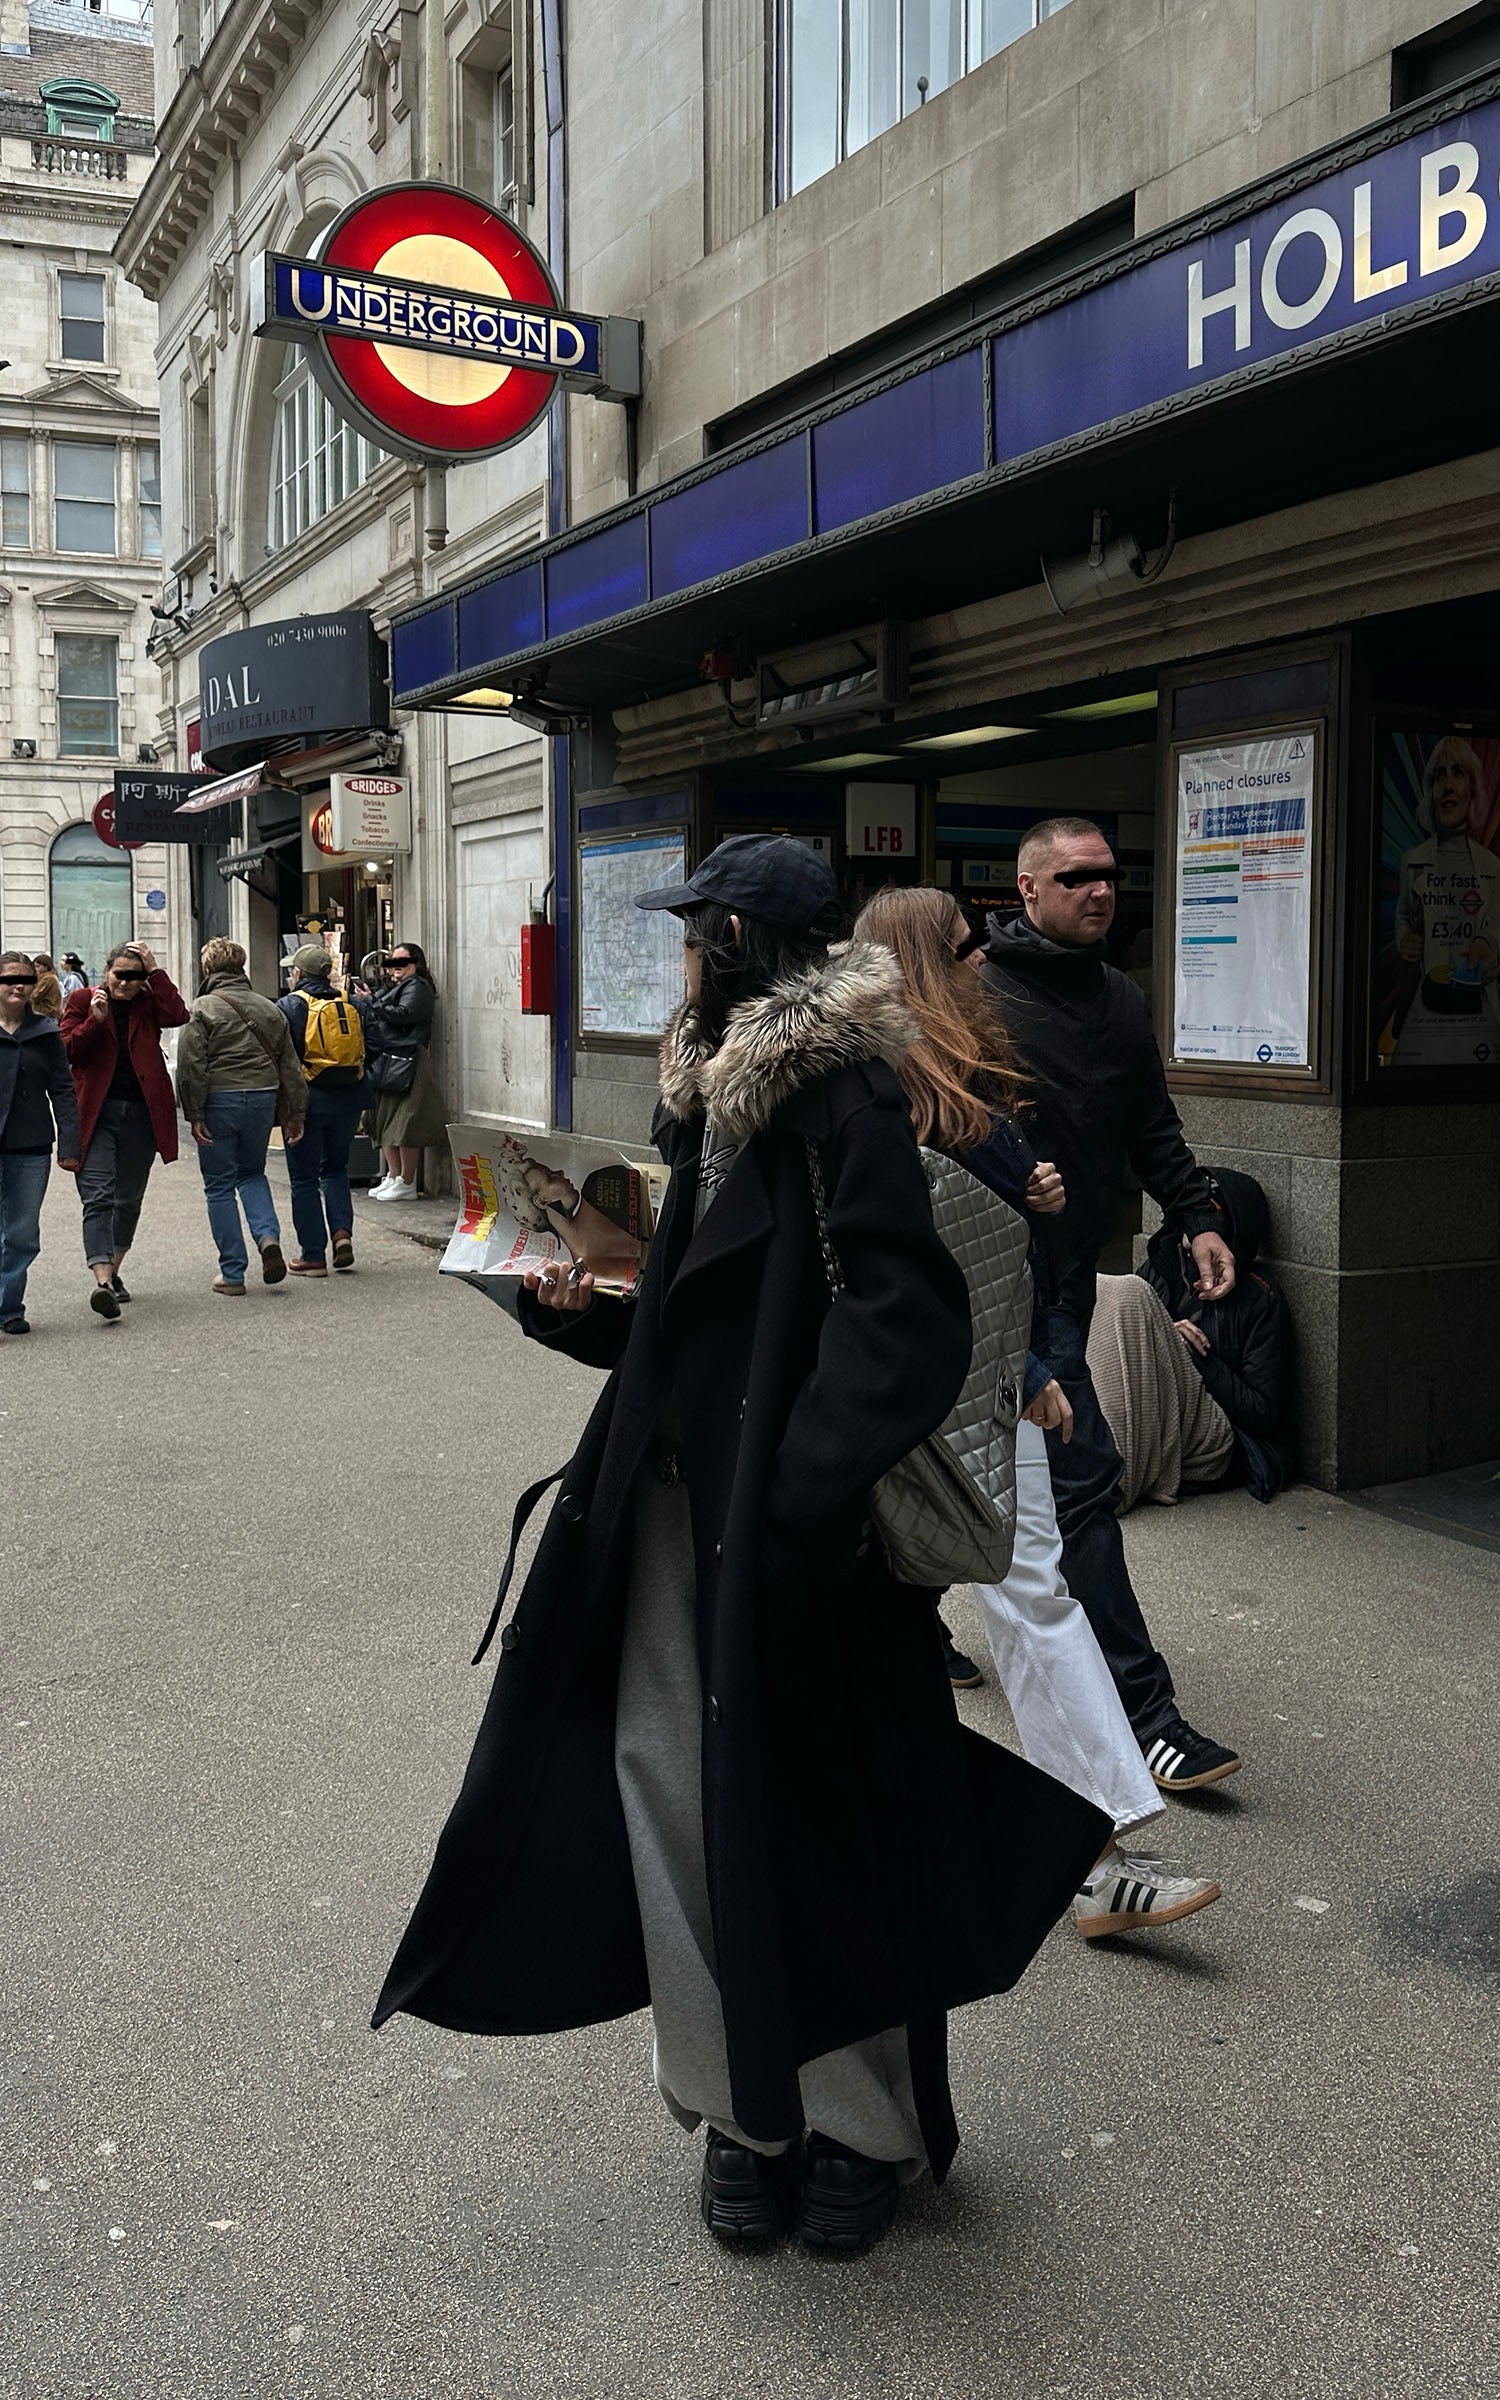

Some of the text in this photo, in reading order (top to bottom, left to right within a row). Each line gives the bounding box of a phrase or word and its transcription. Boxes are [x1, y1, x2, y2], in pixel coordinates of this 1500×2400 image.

[1188, 141, 1500, 370] HOLB
[290, 268, 587, 368] UNDERGROUND
[267, 631, 285, 648] 020
[318, 623, 347, 639] 9006
[351, 779, 397, 794] BRIDGES
[1185, 771, 1291, 795] Planned closures
[121, 781, 200, 803] 阿斯
[363, 799, 385, 807] Drinks
[362, 812, 387, 820] Snacks
[1241, 807, 1274, 819] September
[361, 825, 390, 834] Tobacco
[1222, 821, 1246, 831] Sunday
[1251, 817, 1278, 828] October
[351, 838, 399, 848] Confectionery
[864, 825, 903, 852] LFB
[1426, 872, 1481, 889] For fast,
[1422, 891, 1456, 906] think
[458, 1154, 486, 1235] METAL
